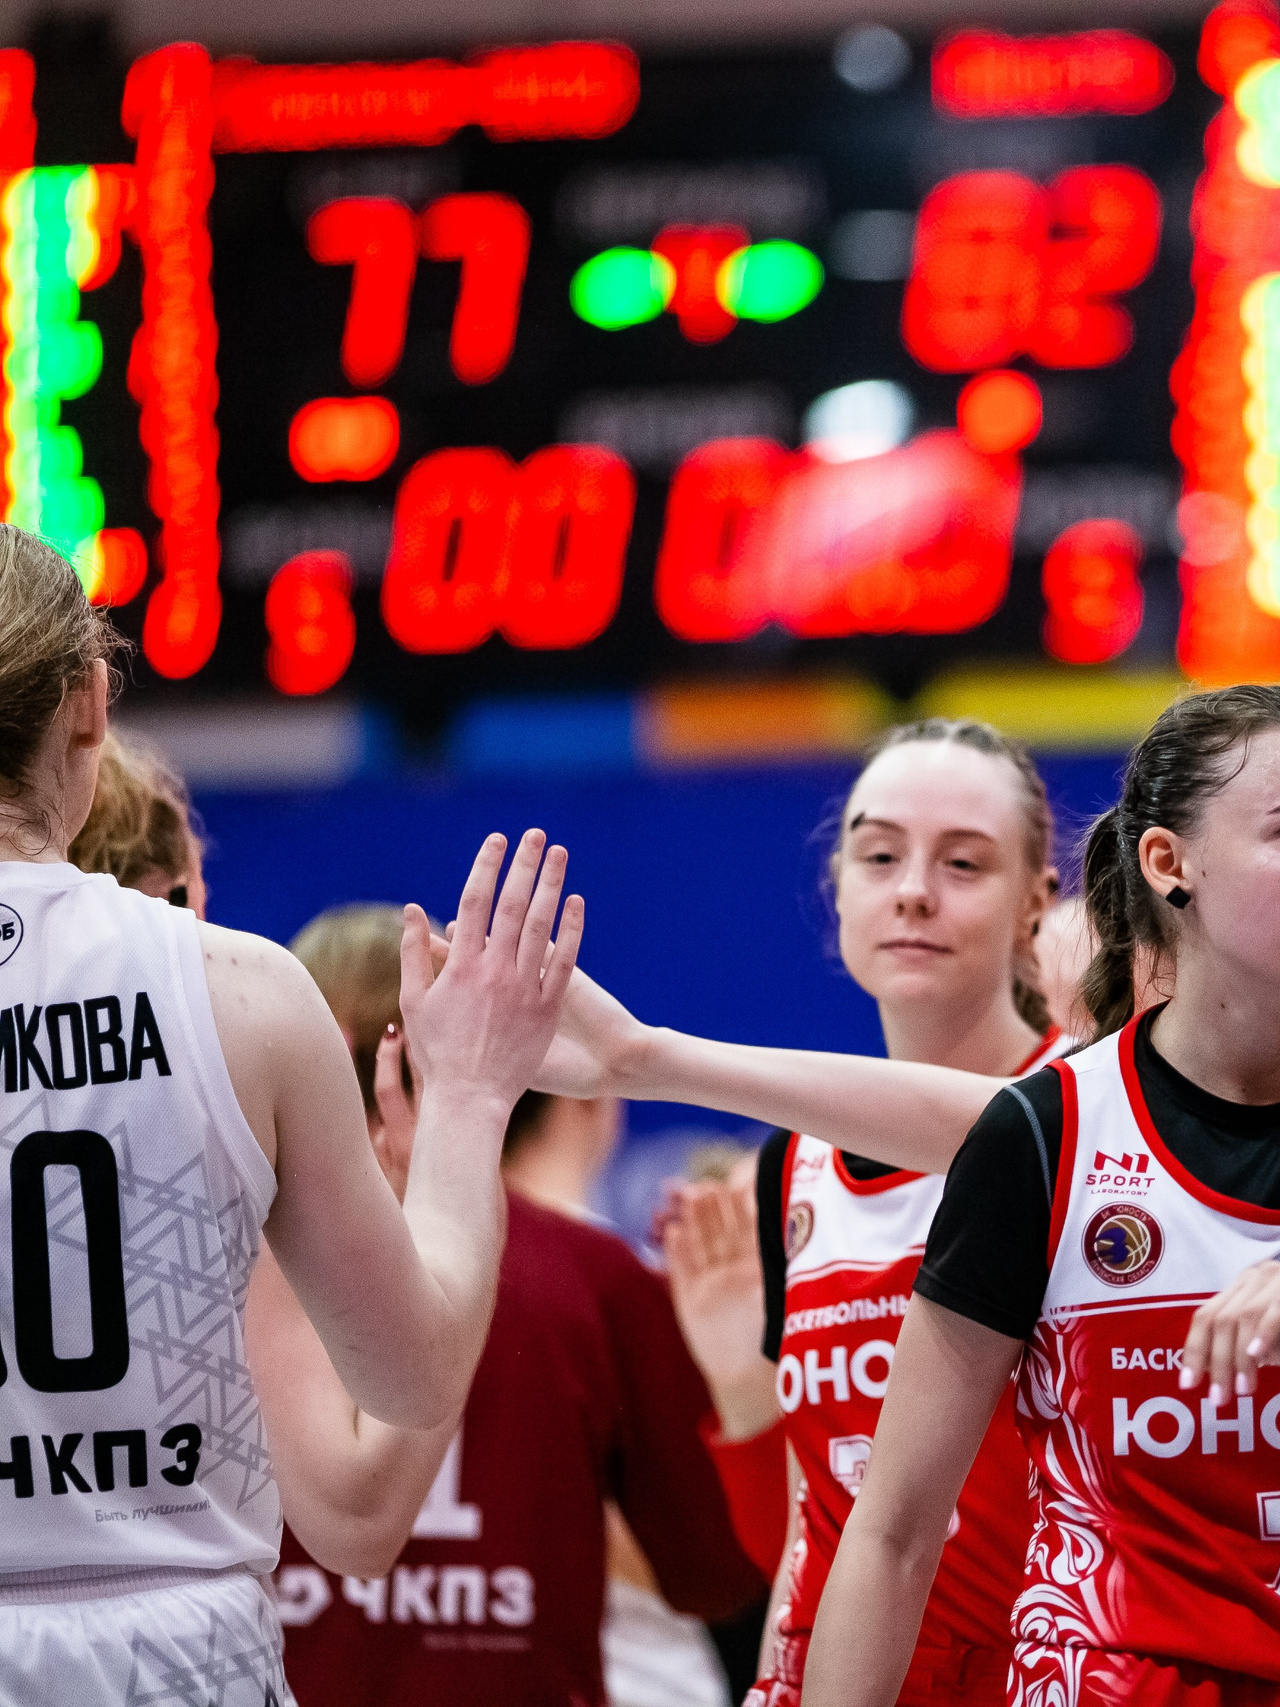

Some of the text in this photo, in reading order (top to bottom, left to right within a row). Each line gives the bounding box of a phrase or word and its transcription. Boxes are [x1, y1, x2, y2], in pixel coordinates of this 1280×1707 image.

[1085, 1173, 1156, 1188] SPORT
[1090, 1188, 1148, 1197] LABORATORY
[95, 1509, 128, 1522] Быть
